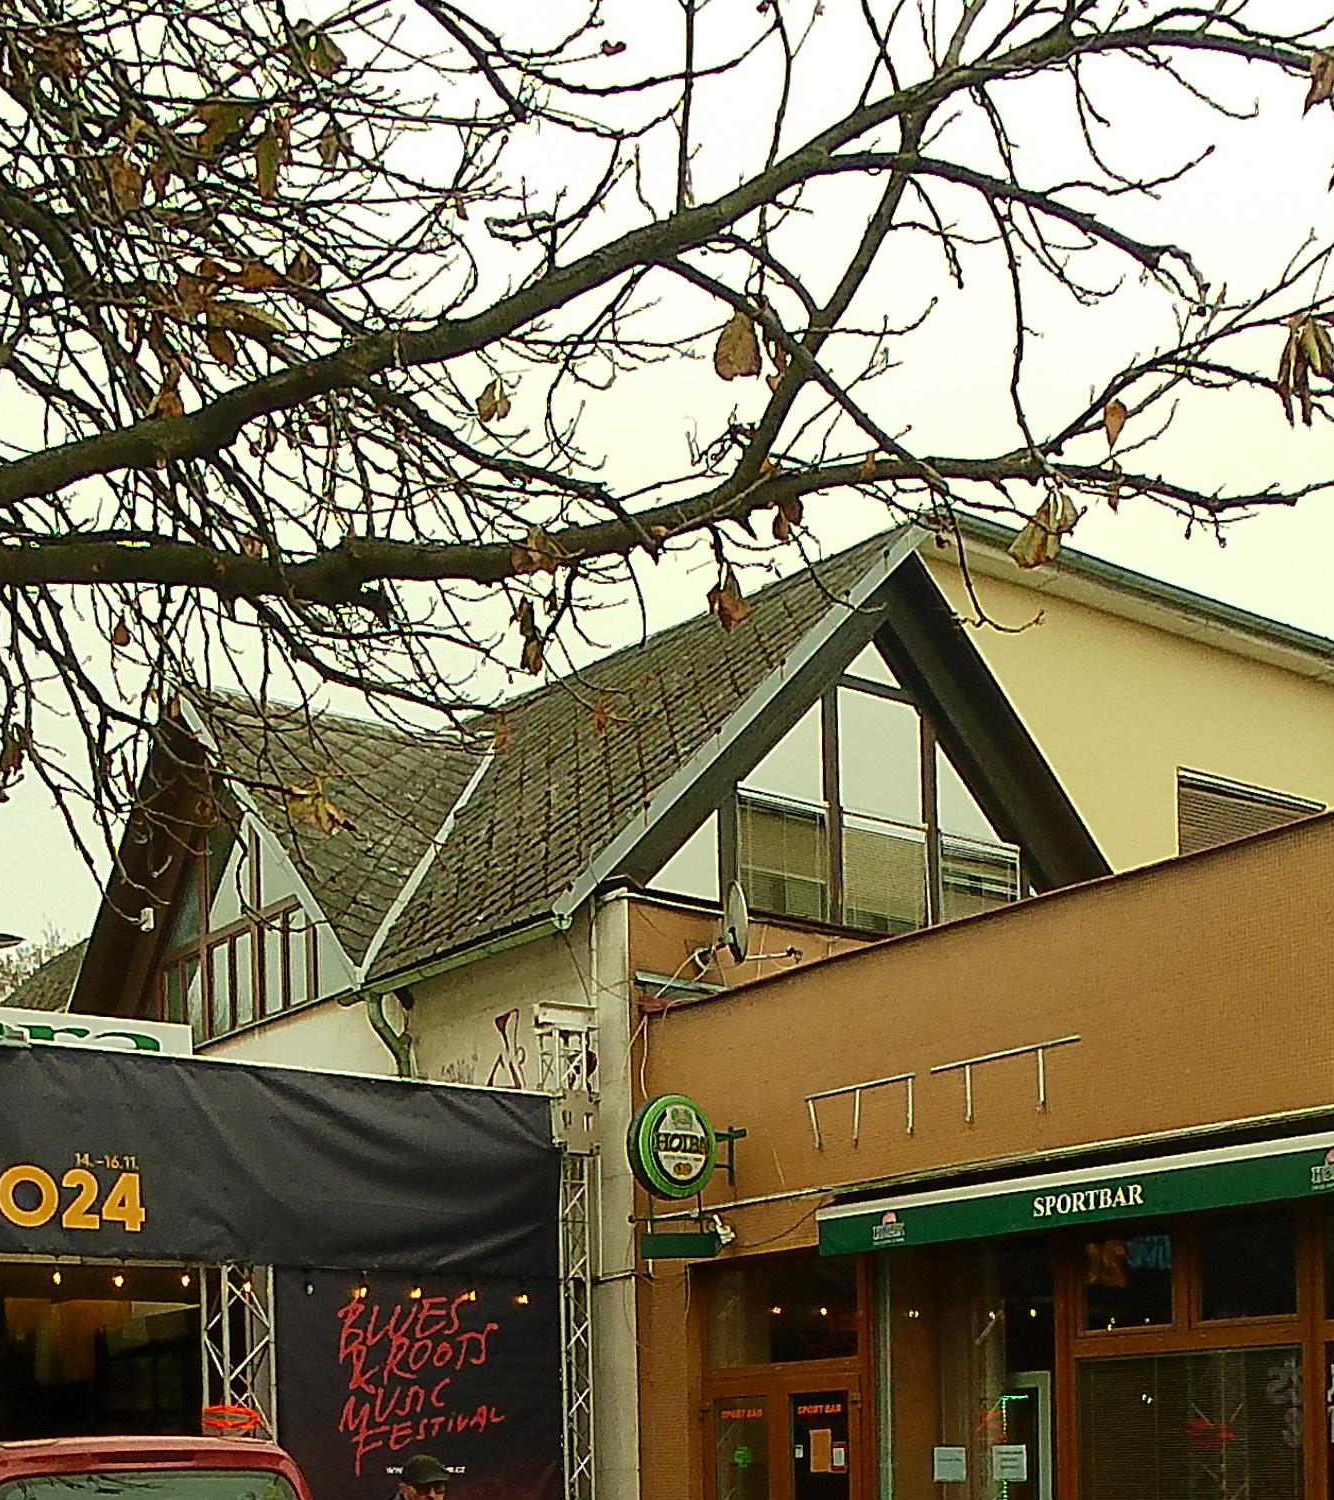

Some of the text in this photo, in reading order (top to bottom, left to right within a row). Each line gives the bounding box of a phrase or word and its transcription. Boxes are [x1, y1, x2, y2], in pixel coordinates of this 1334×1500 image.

[1033, 1184, 1144, 1218] SPORTBAR
[337, 1293, 473, 1364] BLUES
[383, 1322, 499, 1385] ROOTS
